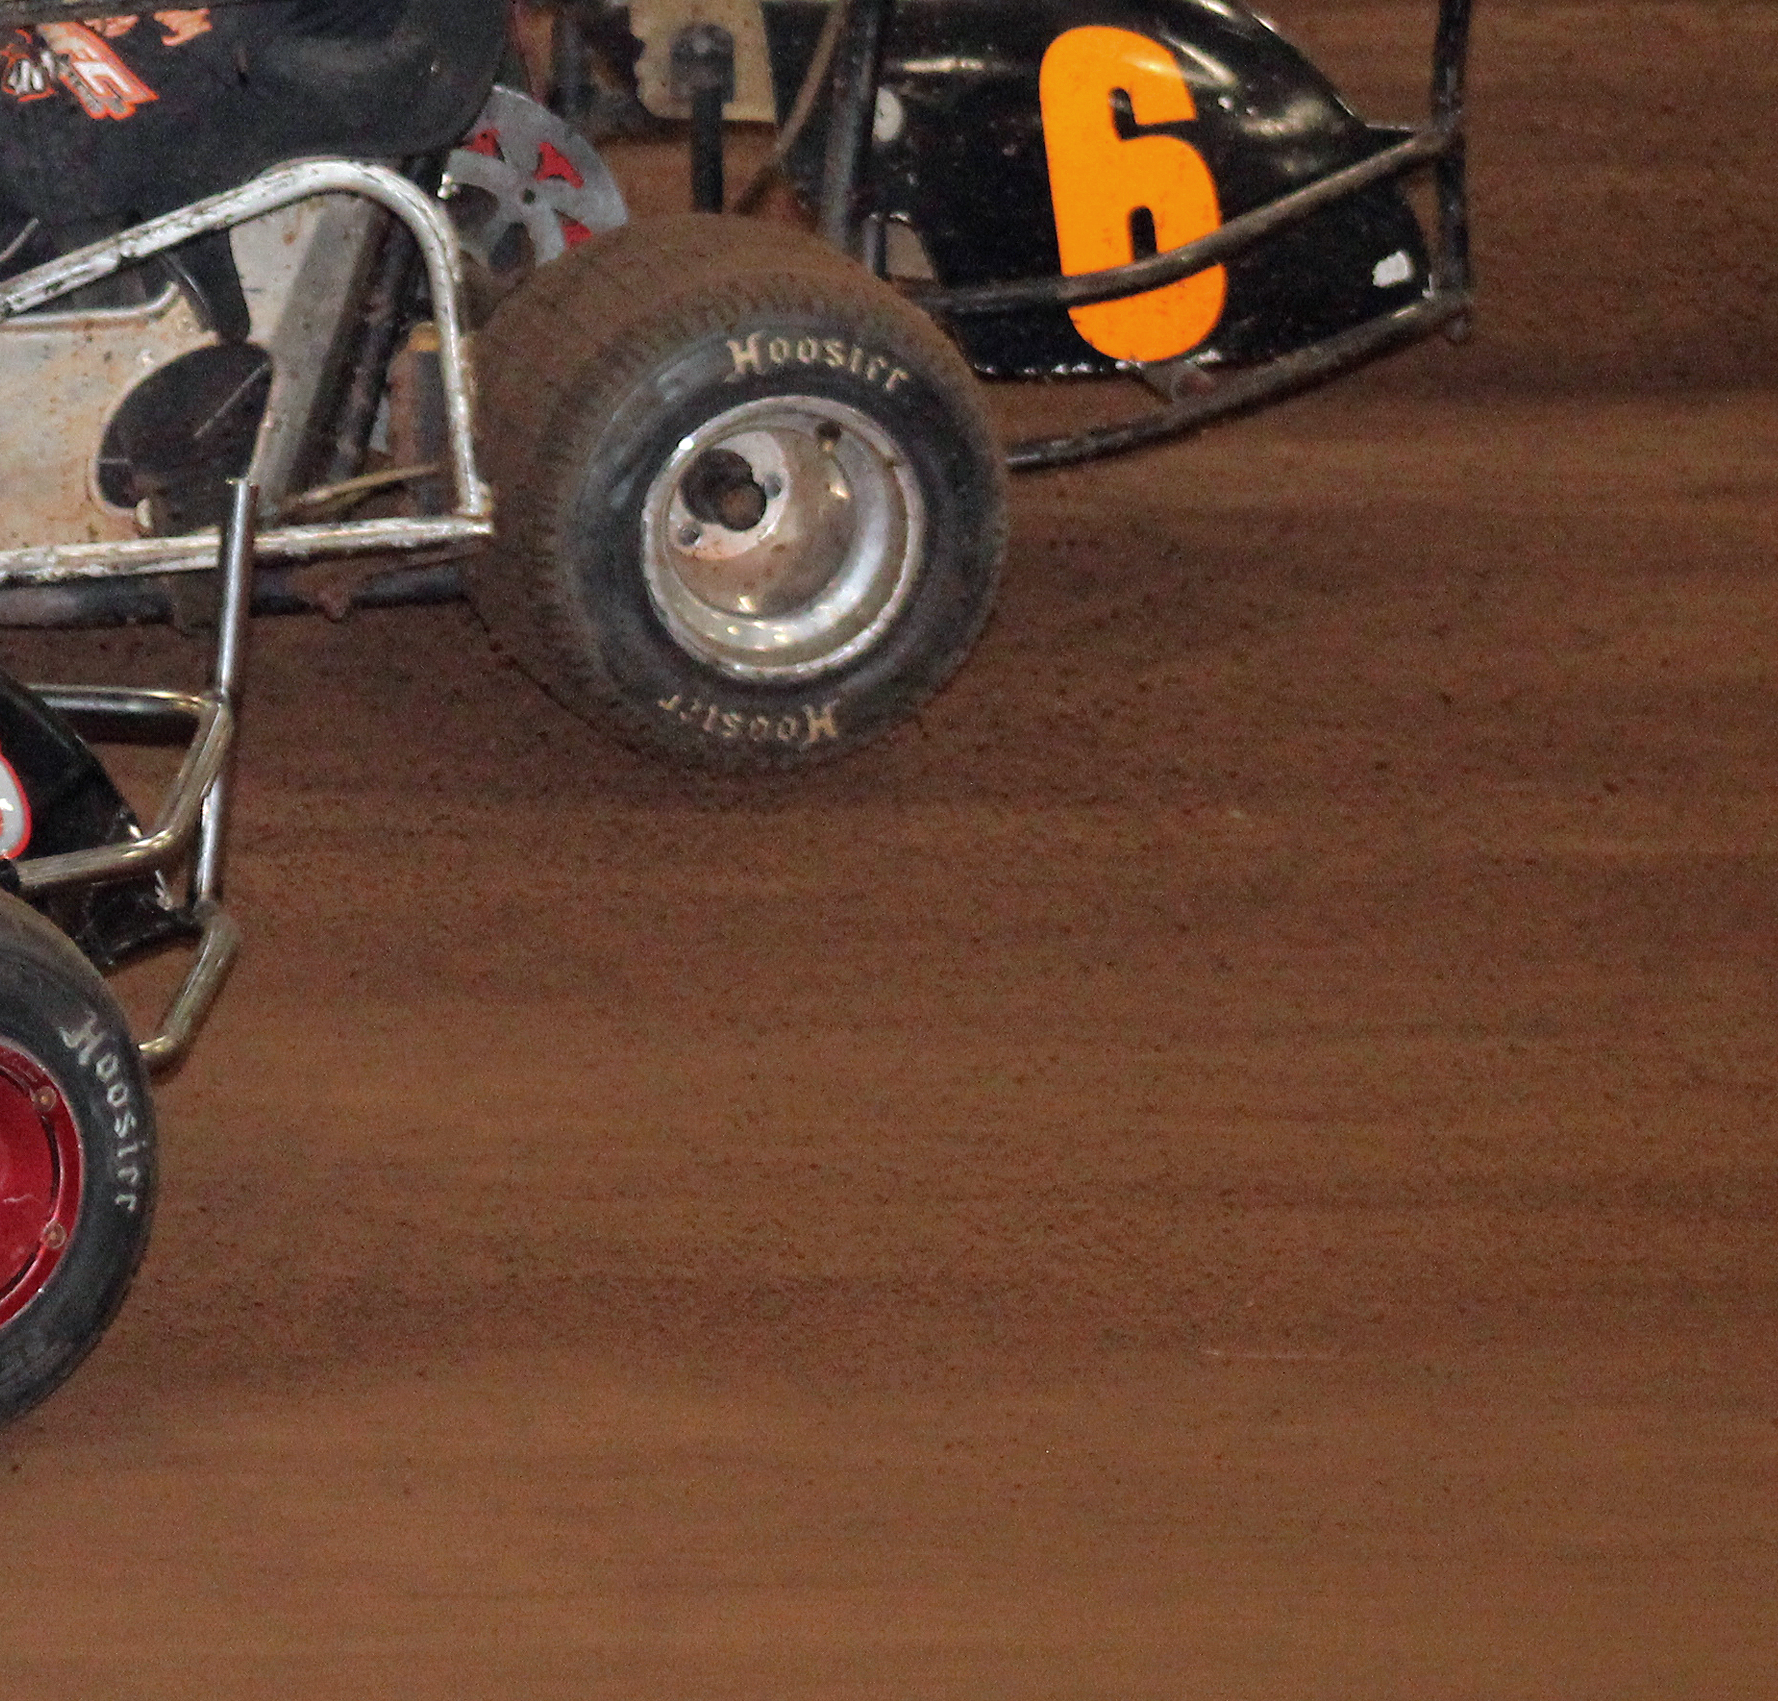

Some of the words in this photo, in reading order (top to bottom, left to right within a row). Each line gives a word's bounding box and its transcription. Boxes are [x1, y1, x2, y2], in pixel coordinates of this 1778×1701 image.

[1039, 25, 1226, 362] 6
[725, 328, 912, 393] Hoosier
[656, 691, 839, 746] Hoosier
[57, 1010, 140, 1214] Hoosier
